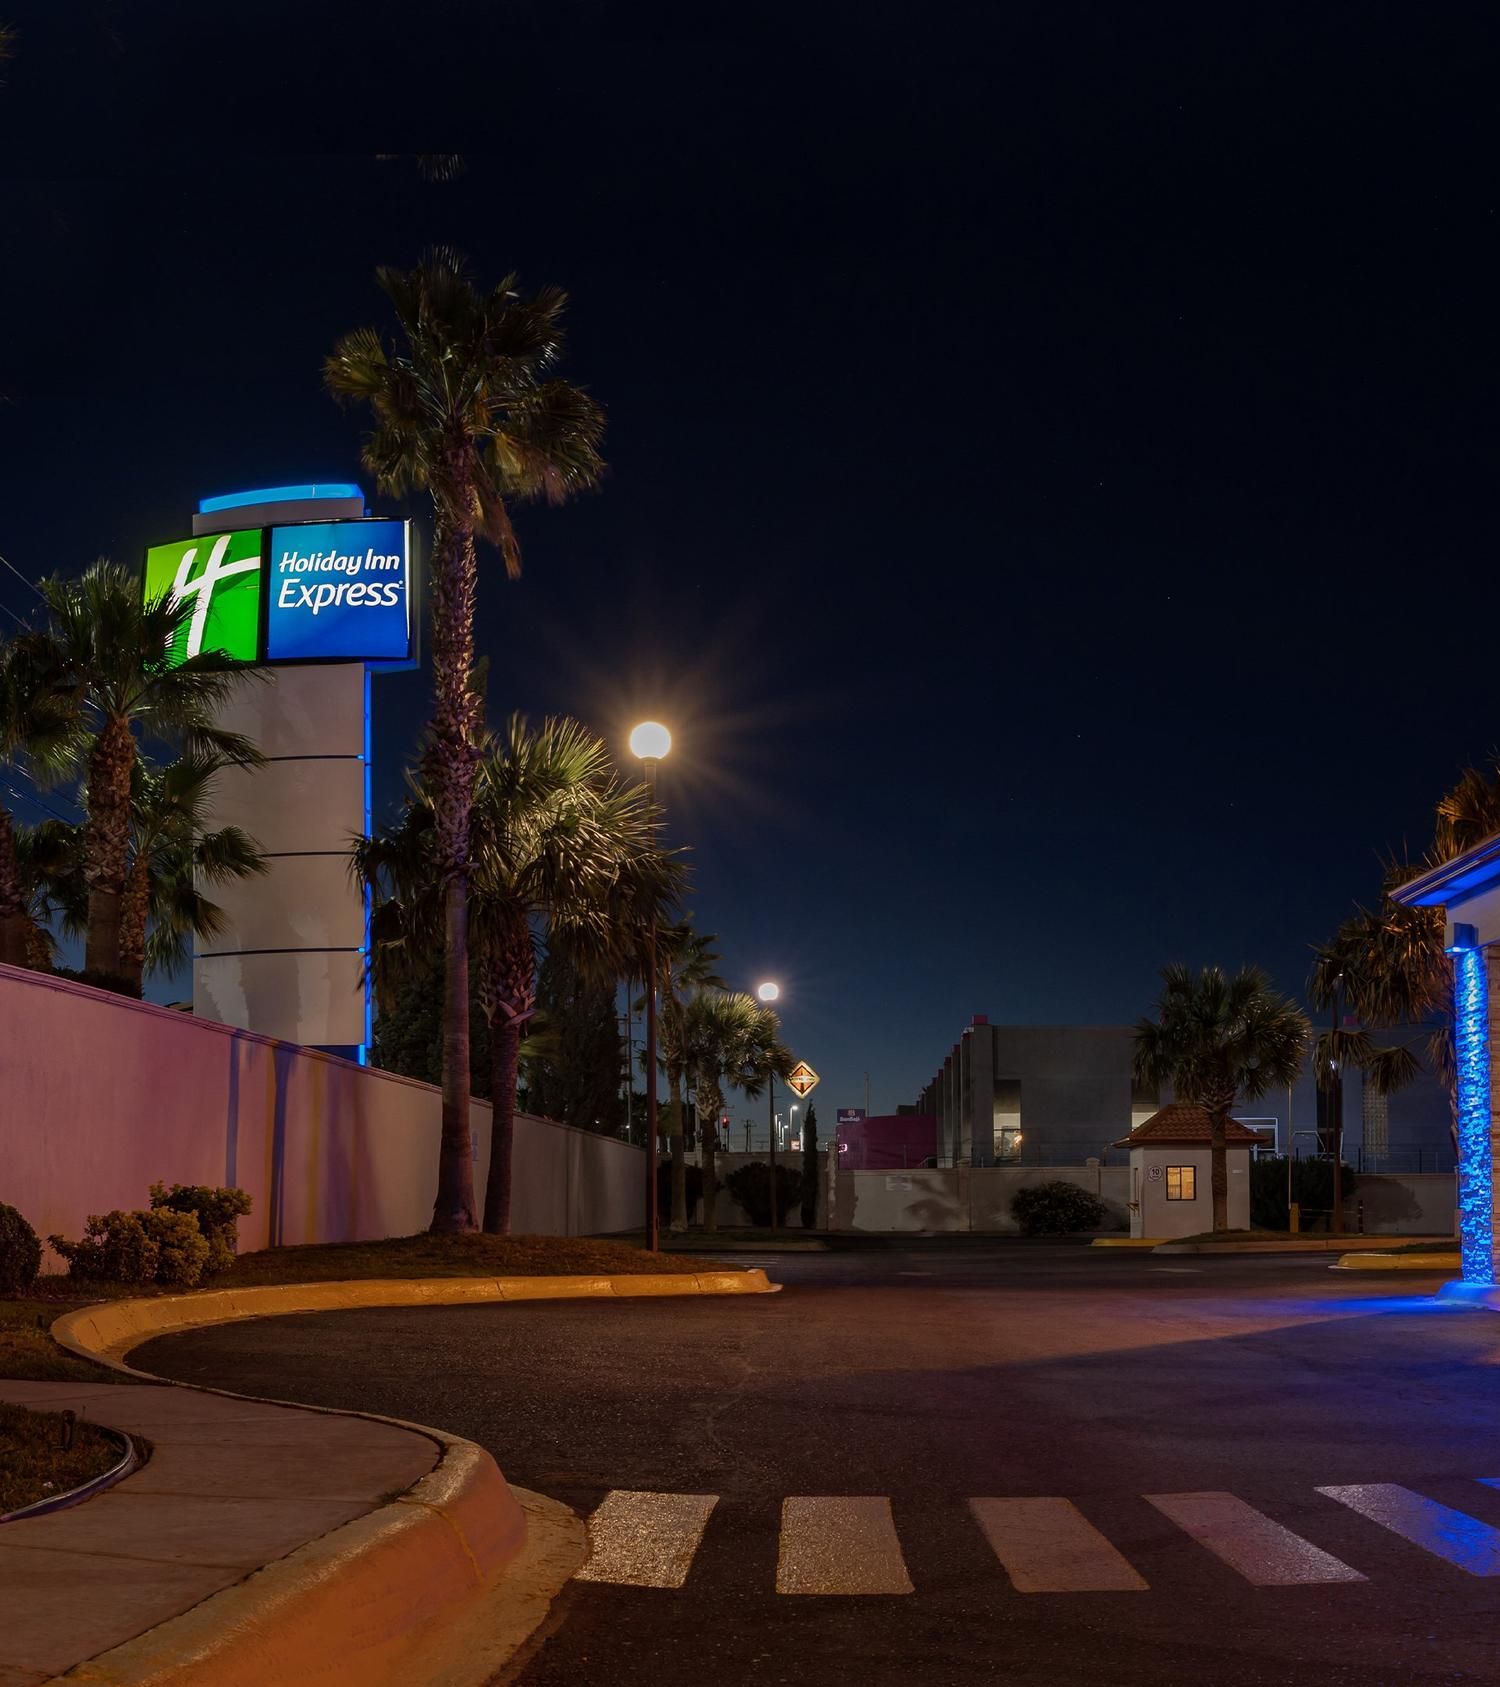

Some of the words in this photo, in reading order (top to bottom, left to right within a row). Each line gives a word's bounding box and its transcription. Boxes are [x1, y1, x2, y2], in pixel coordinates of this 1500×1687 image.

[279, 550, 362, 576] Holiday
[364, 548, 401, 571] Inn
[278, 578, 400, 616] Express
